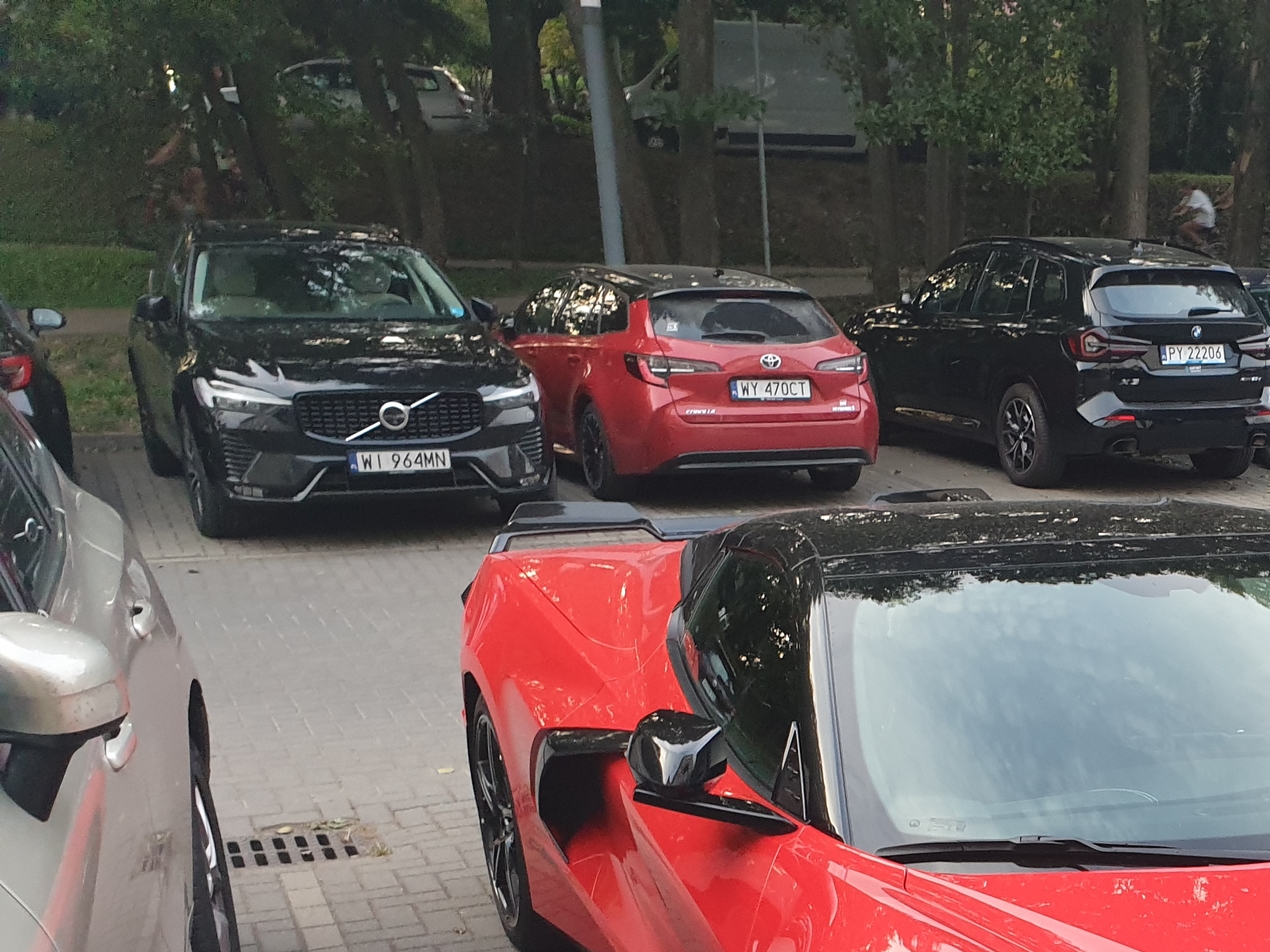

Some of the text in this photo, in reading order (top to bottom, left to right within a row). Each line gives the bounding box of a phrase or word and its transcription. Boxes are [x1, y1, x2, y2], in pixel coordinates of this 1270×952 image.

[1168, 346, 1184, 361] PY
[1187, 346, 1222, 360] 22206
[740, 381, 806, 397] WY 470CT
[361, 451, 447, 470] WI 964MN
